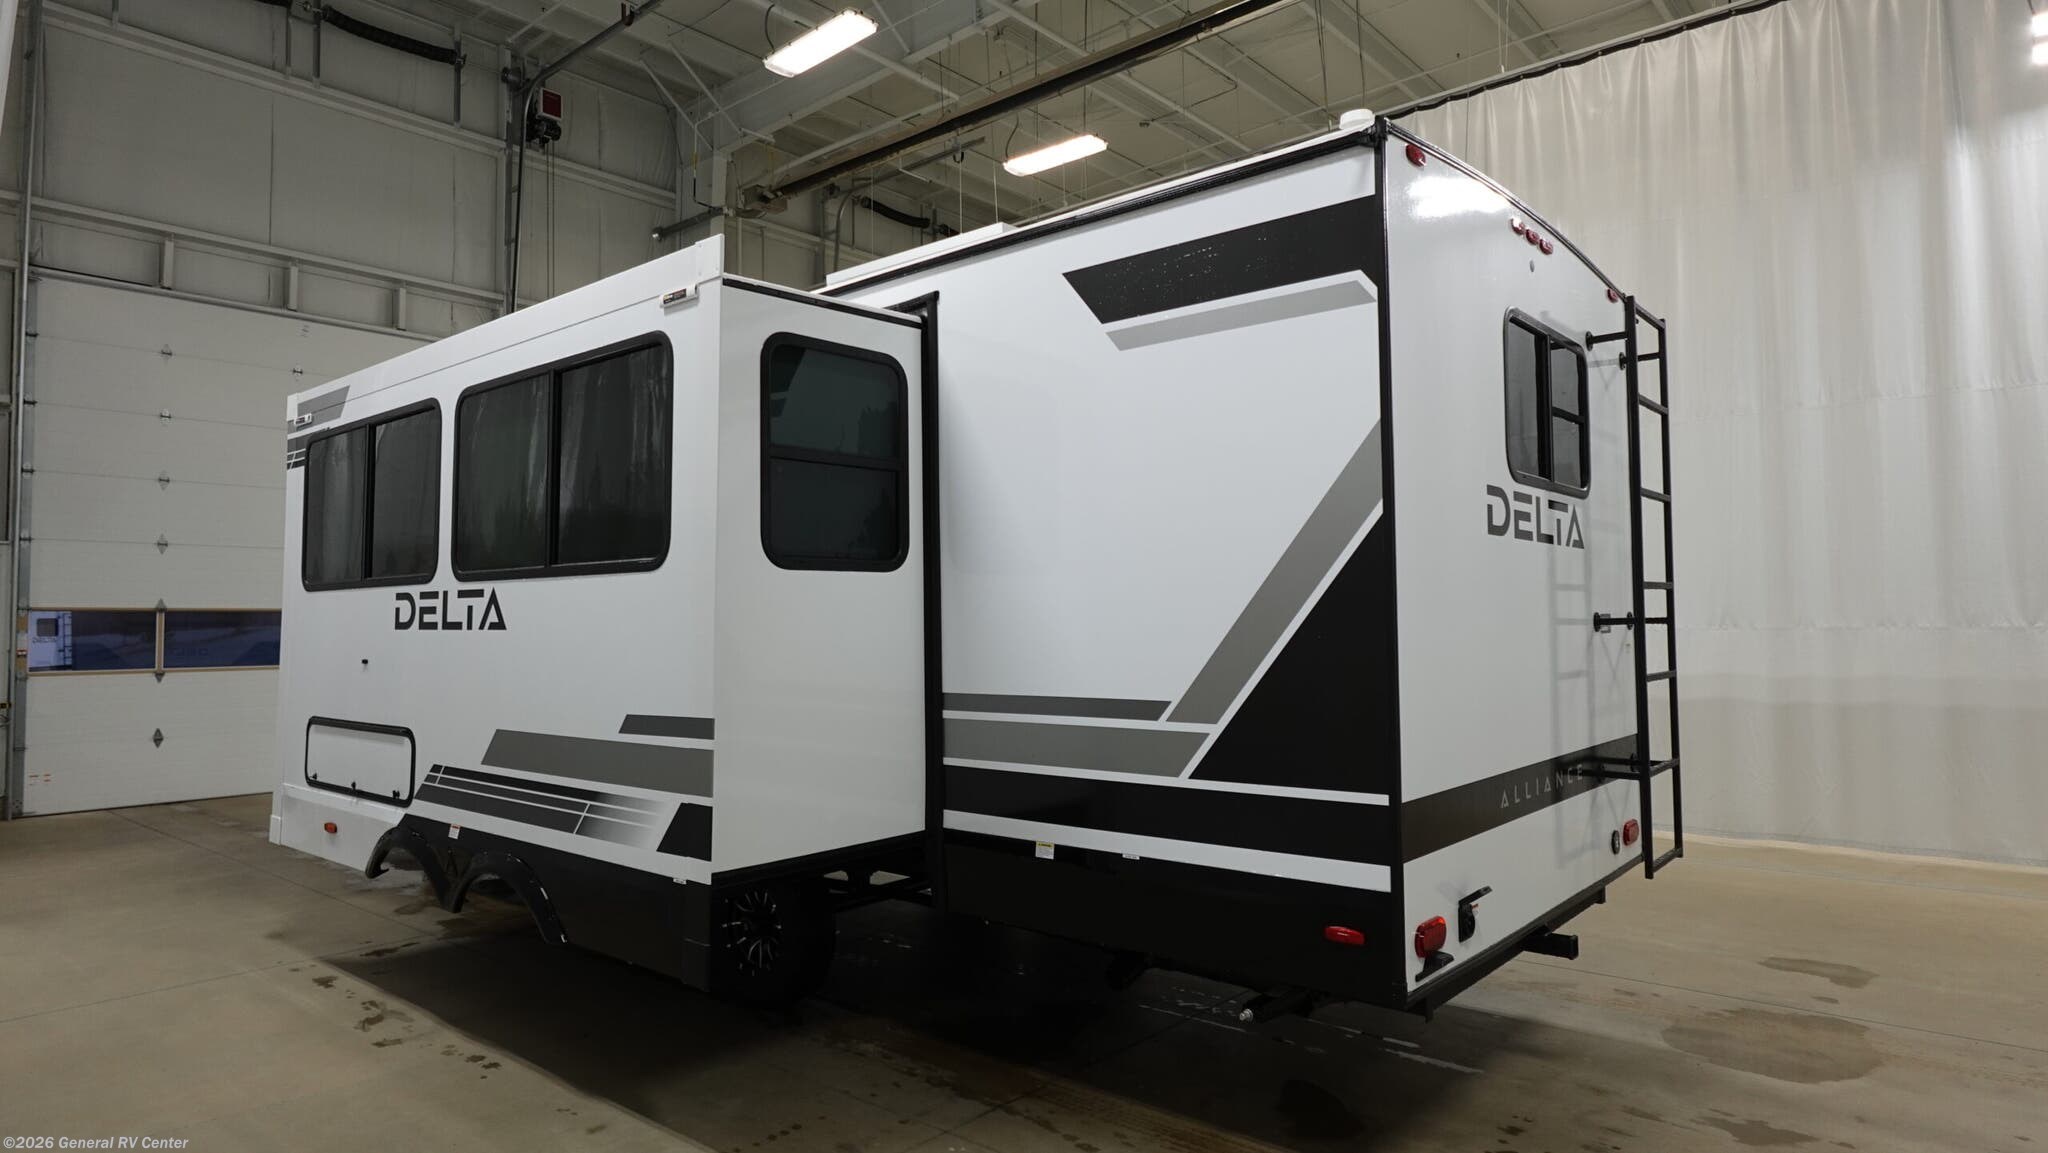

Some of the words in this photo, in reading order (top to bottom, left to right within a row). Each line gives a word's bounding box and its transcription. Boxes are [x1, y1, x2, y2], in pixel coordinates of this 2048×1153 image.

[1486, 484, 1585, 549] DELTA
[394, 587, 507, 630] DELTA
[1501, 764, 1583, 809] ALLIANCE
